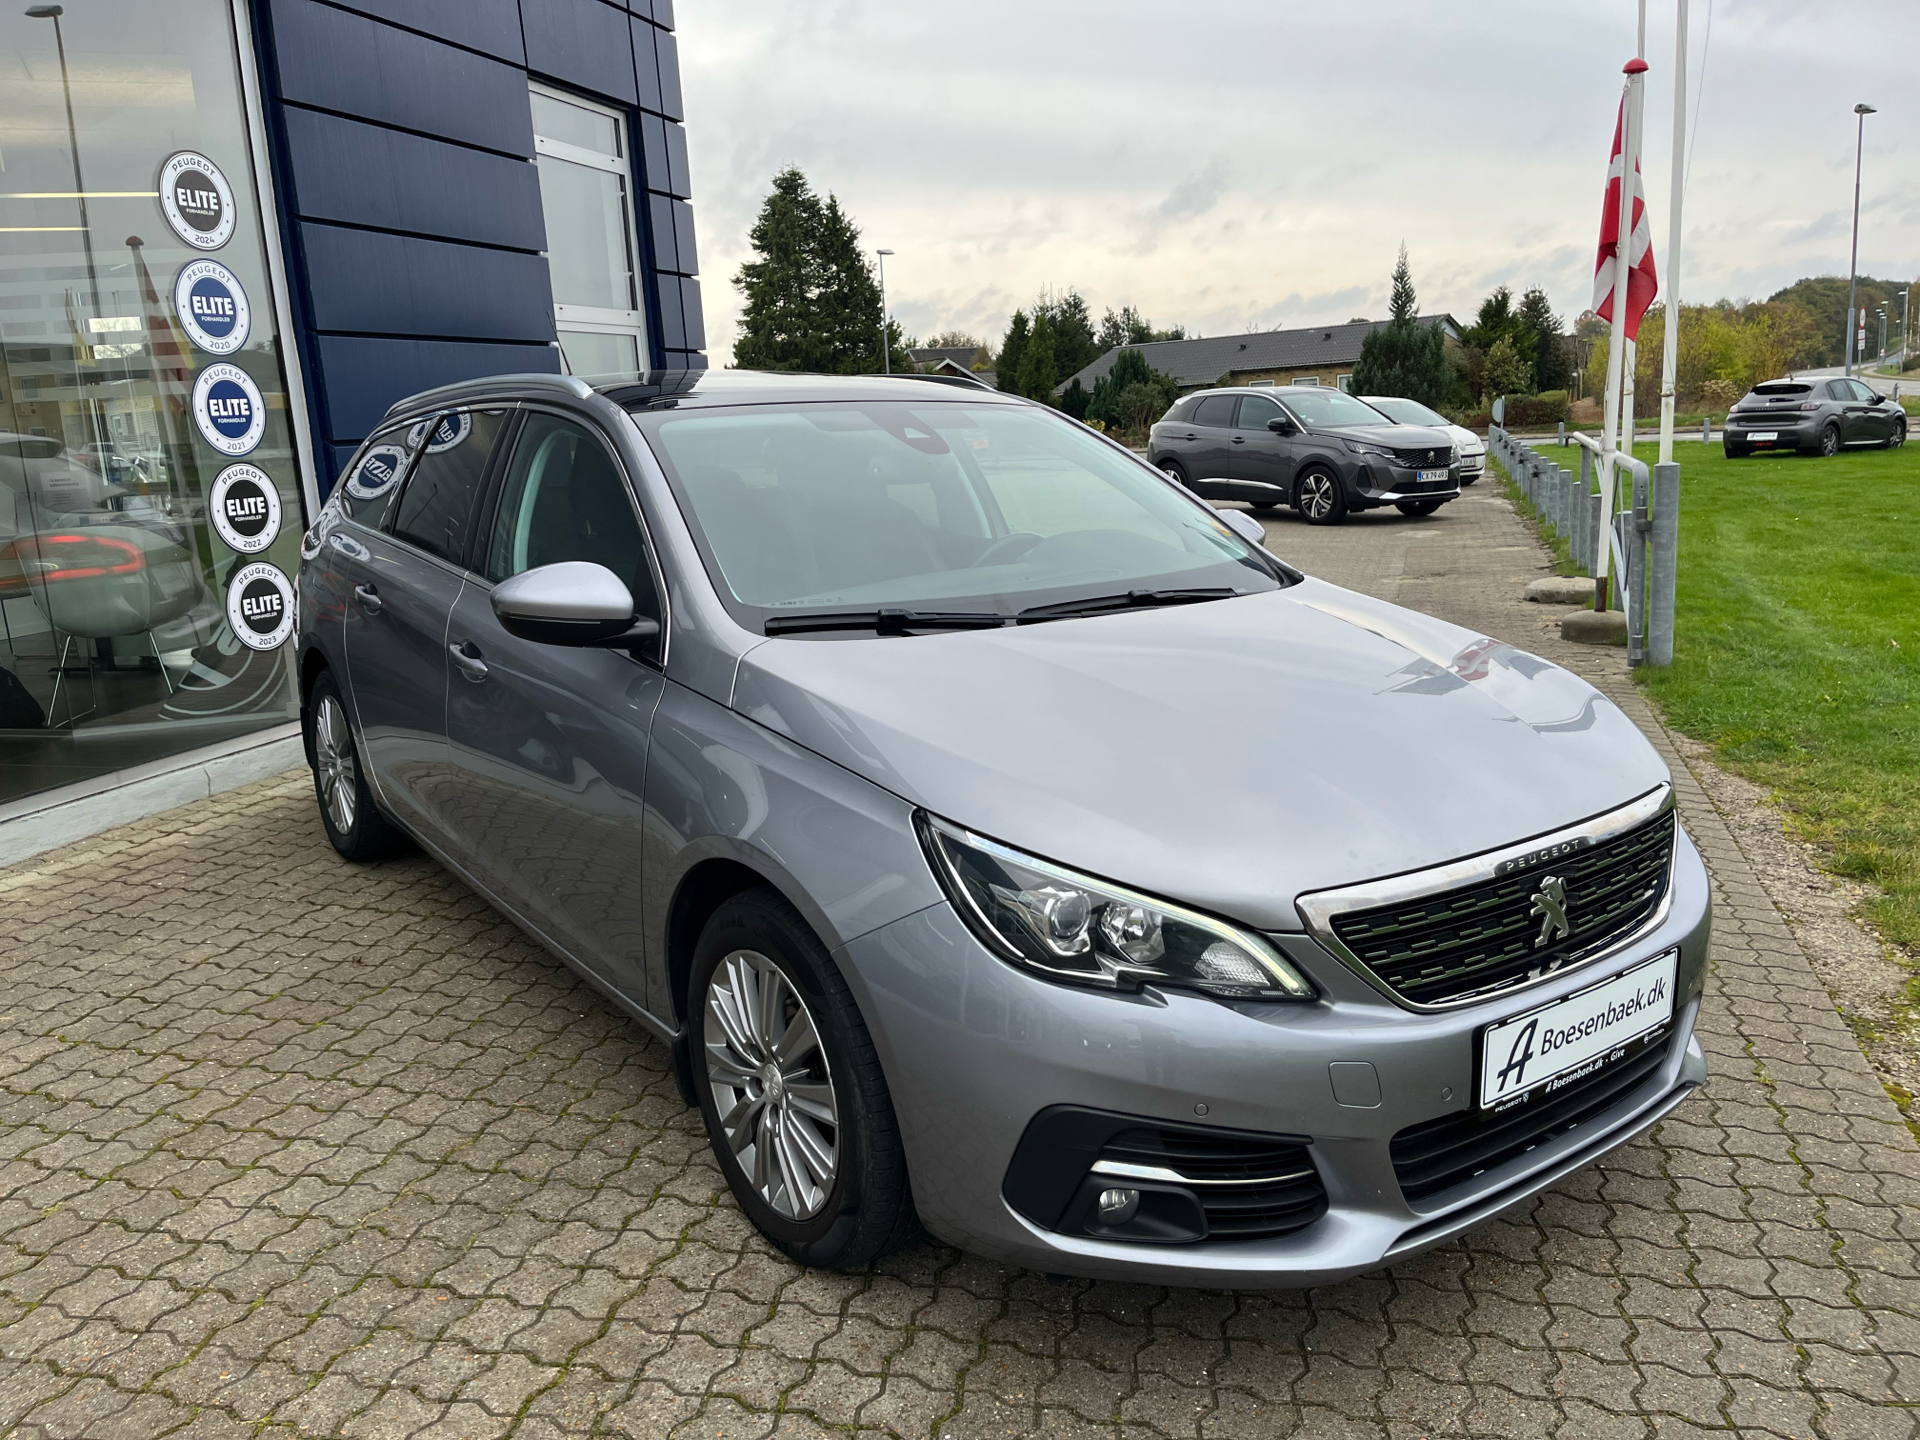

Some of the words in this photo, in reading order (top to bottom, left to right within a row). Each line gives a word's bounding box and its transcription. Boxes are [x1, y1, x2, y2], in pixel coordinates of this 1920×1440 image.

[172, 158, 215, 176] PEUGEOT
[177, 188, 219, 210] ELITE
[195, 234, 215, 244] 2024
[187, 266, 231, 283] PEUGEOT
[192, 296, 234, 315] ELITE
[210, 341, 230, 350] 2020
[204, 368, 247, 385] PEUGEOT
[209, 399, 250, 416] ELITE
[228, 442, 245, 450] 2021
[222, 468, 262, 485] PEUGEOT
[226, 497, 266, 516] ELITE
[244, 539, 262, 548] 2022
[238, 567, 278, 585] PEUGEOT
[242, 594, 281, 615] ELITE
[259, 636, 277, 645] 2023
[1506, 840, 1579, 871] PEUGEOT
[1497, 1018, 1539, 1092] A
[1541, 977, 1666, 1056] Boesenbaek.dk
[1553, 1058, 1604, 1090] Boesenbaek.dk
[1610, 1049, 1625, 1061] Give
[1495, 1097, 1522, 1113] PEUGEOT
